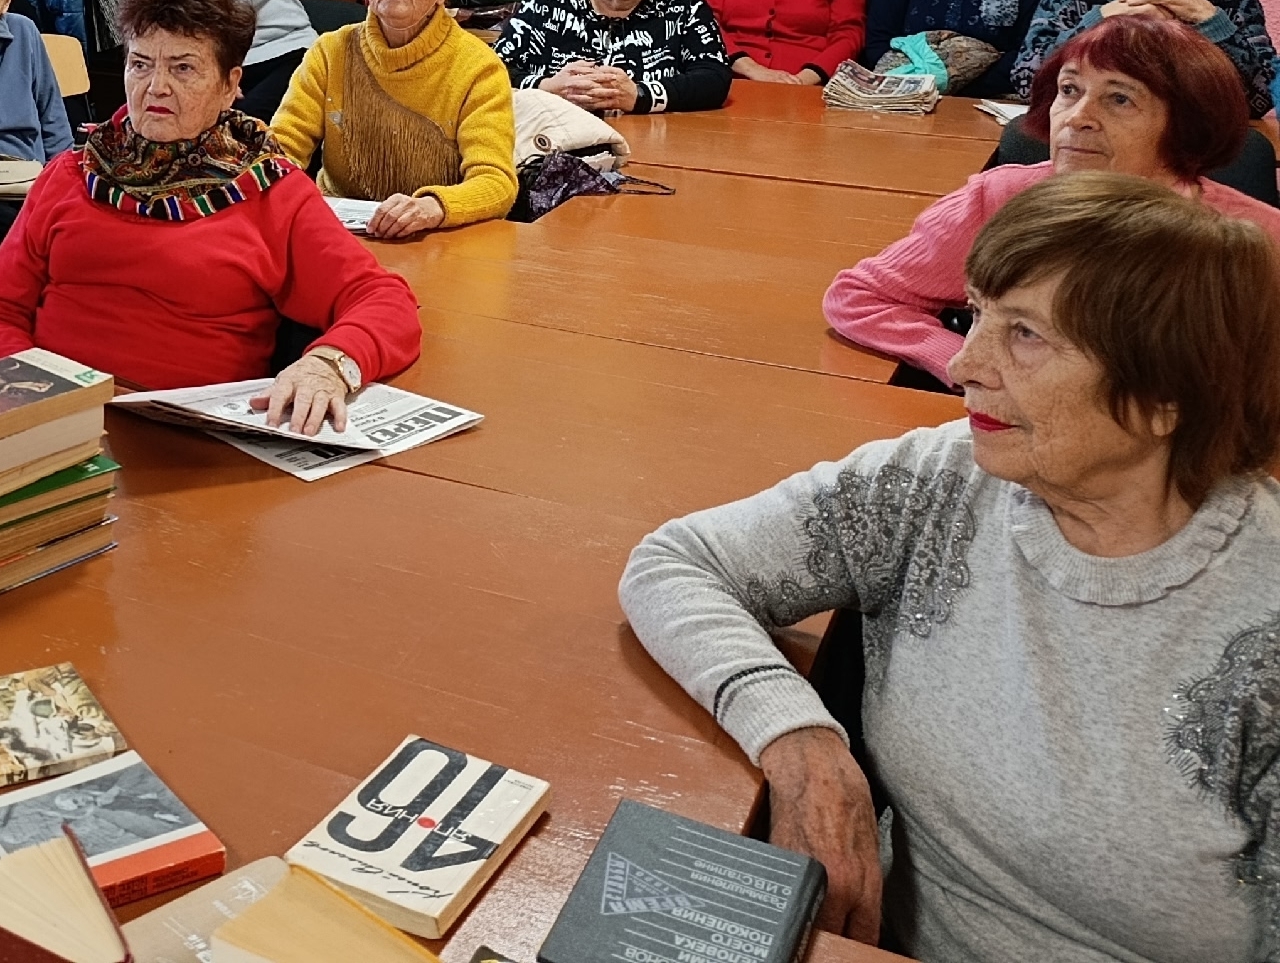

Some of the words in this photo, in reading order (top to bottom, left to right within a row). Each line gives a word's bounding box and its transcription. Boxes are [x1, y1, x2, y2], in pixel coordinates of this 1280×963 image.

[535, 2, 550, 16] UP
[326, 739, 508, 874] 46
[690, 872, 787, 909] Размышления
[672, 907, 773, 944] ПОКОЛЕНИЯ
[674, 934, 758, 963] ЕЛОВЕКА
[711, 933, 769, 958] МОЕГО
